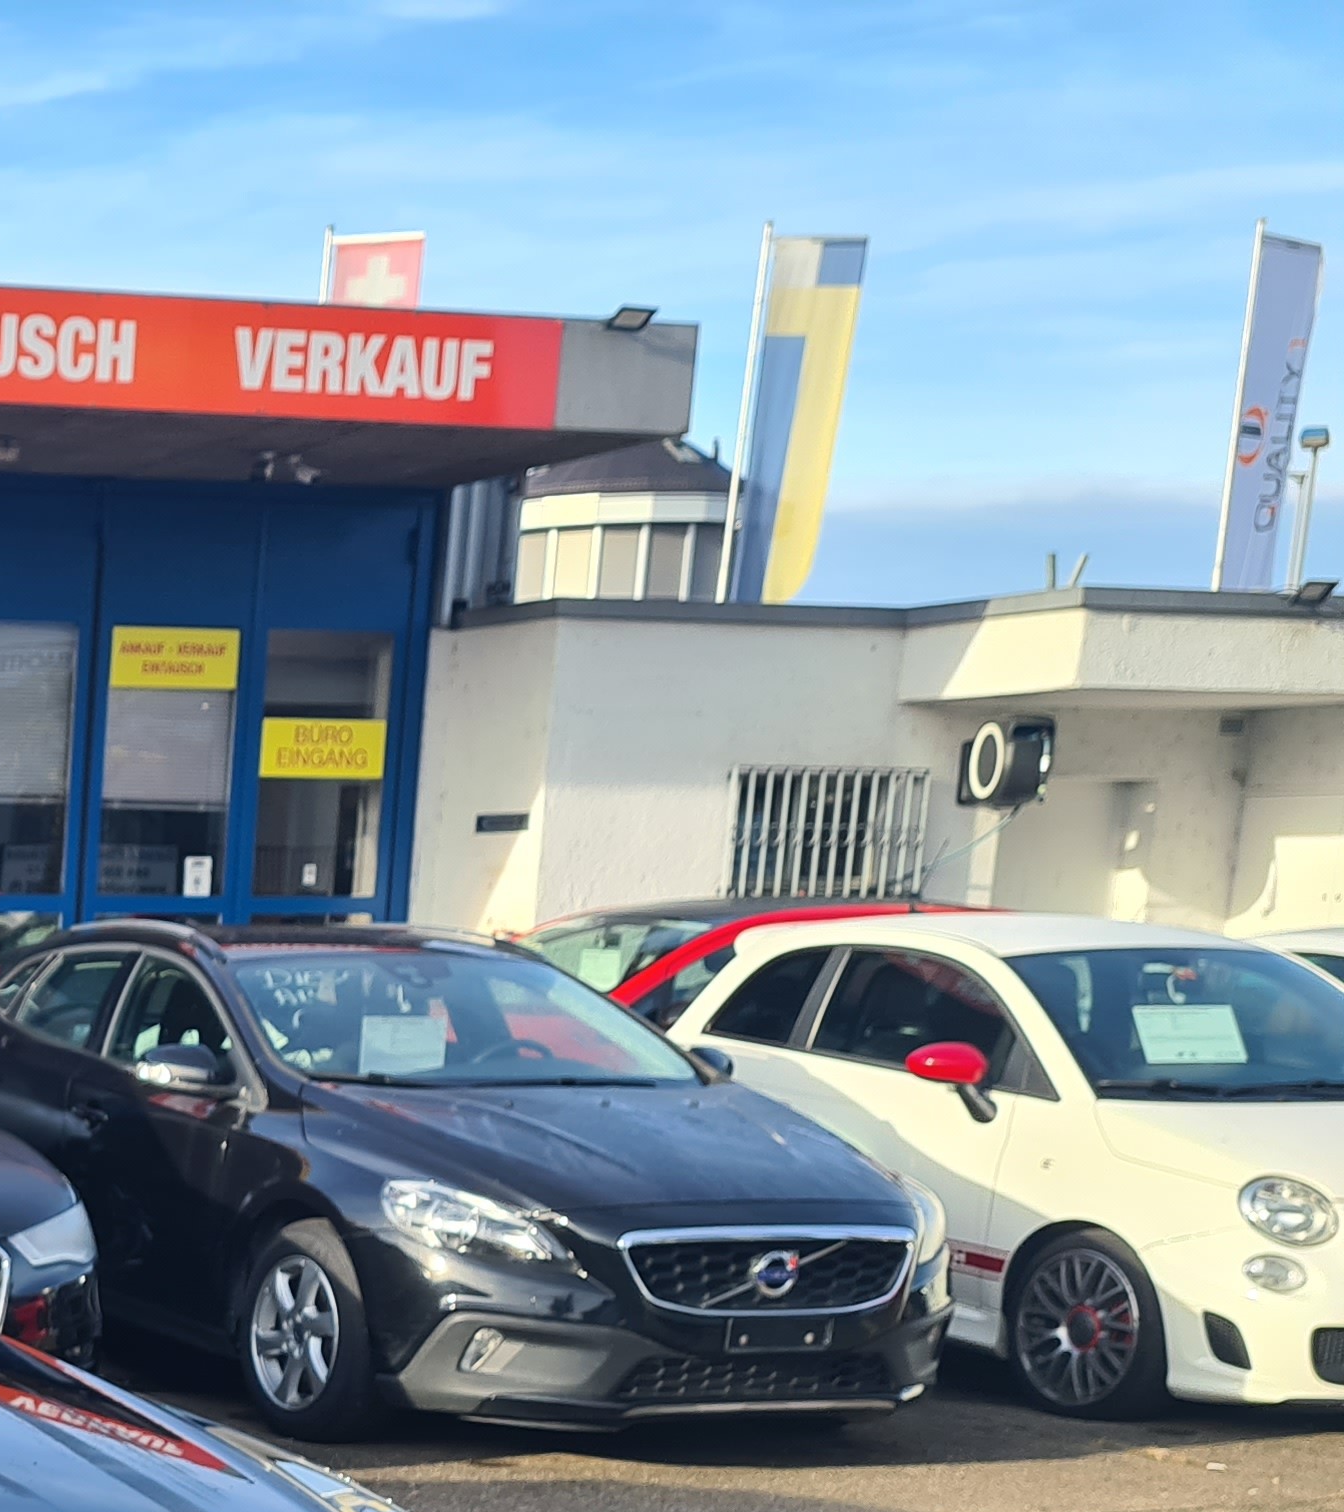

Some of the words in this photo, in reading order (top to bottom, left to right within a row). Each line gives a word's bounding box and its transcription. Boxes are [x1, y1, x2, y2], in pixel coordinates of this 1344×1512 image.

[234, 326, 494, 403] VERKAUF
[1253, 359, 1302, 533] QUALITY
[276, 747, 369, 769] EINGANG
